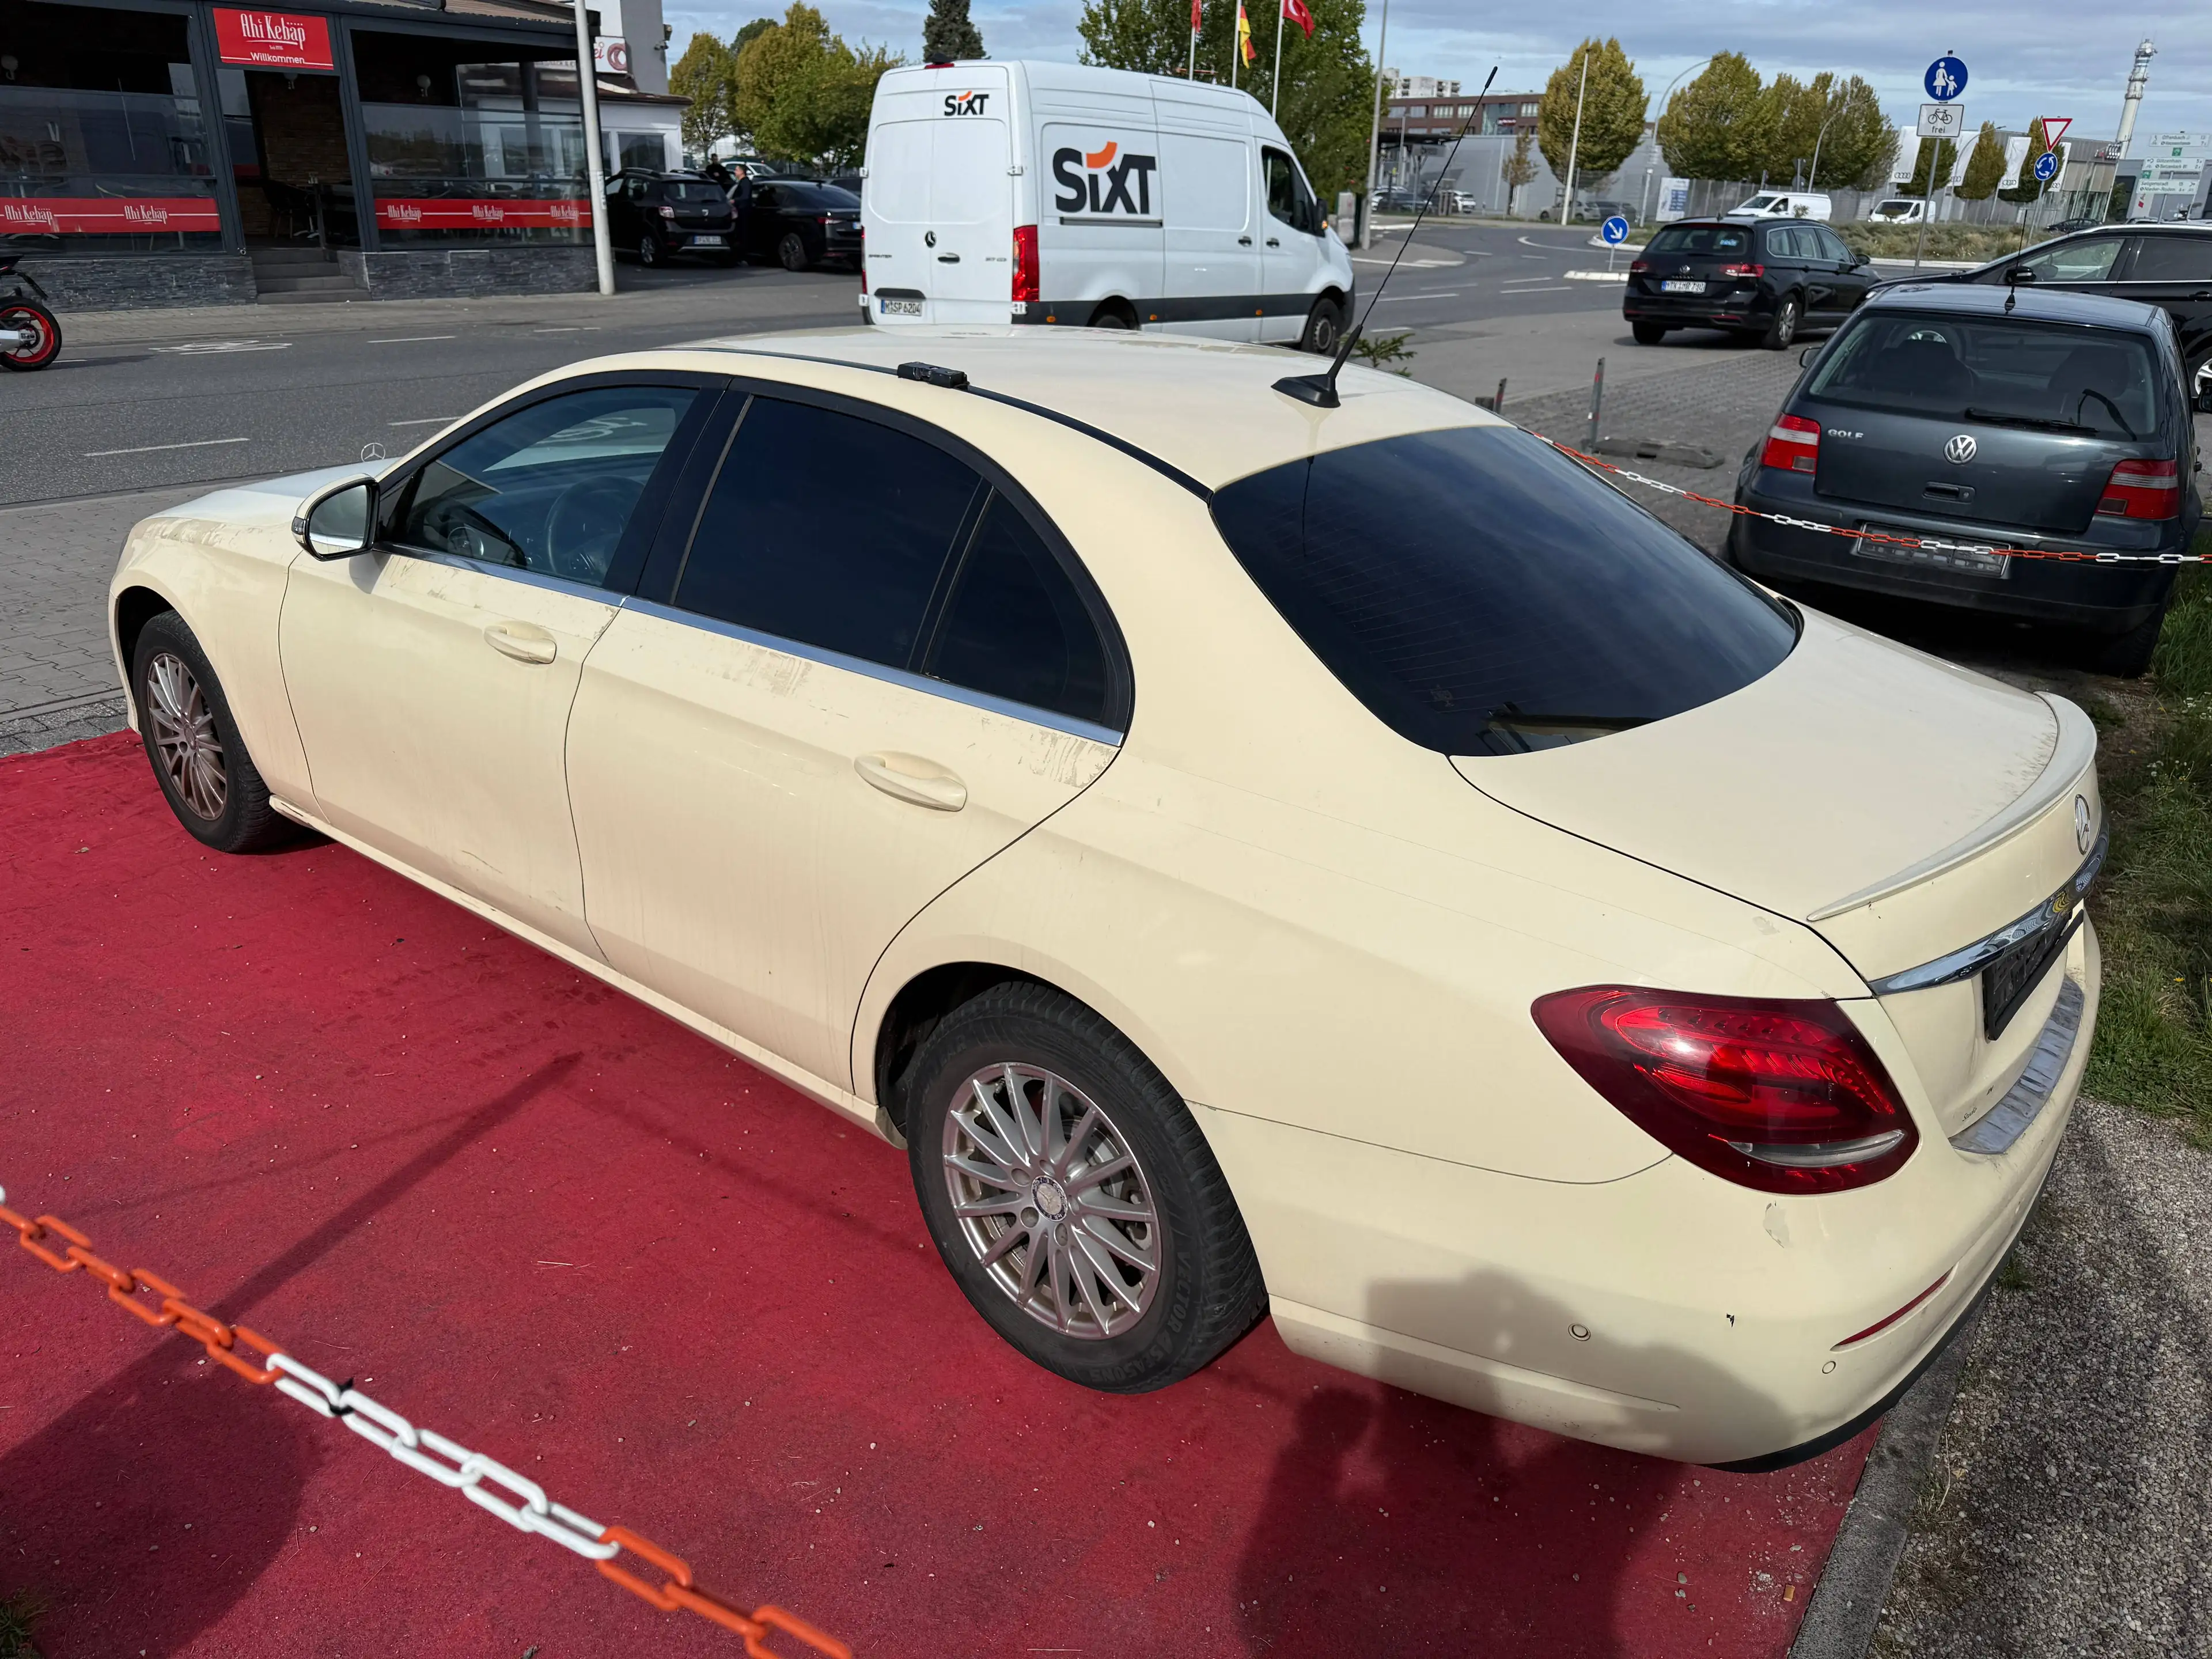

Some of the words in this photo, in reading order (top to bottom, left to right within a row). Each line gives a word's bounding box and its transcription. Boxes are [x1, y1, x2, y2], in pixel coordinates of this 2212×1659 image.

[240, 13, 264, 38] Ahi
[264, 15, 305, 51] Kebap
[250, 52, 305, 64] Willkommen
[1931, 126, 1945, 134] frei
[4, 205, 22, 220] Ahi
[22, 205, 53, 225] Kebap
[124, 205, 140, 219] Ahi
[141, 205, 168, 224] Kebap
[1827, 429, 1864, 440] GOLF
[1166, 1251, 1191, 1334] VECTOR
